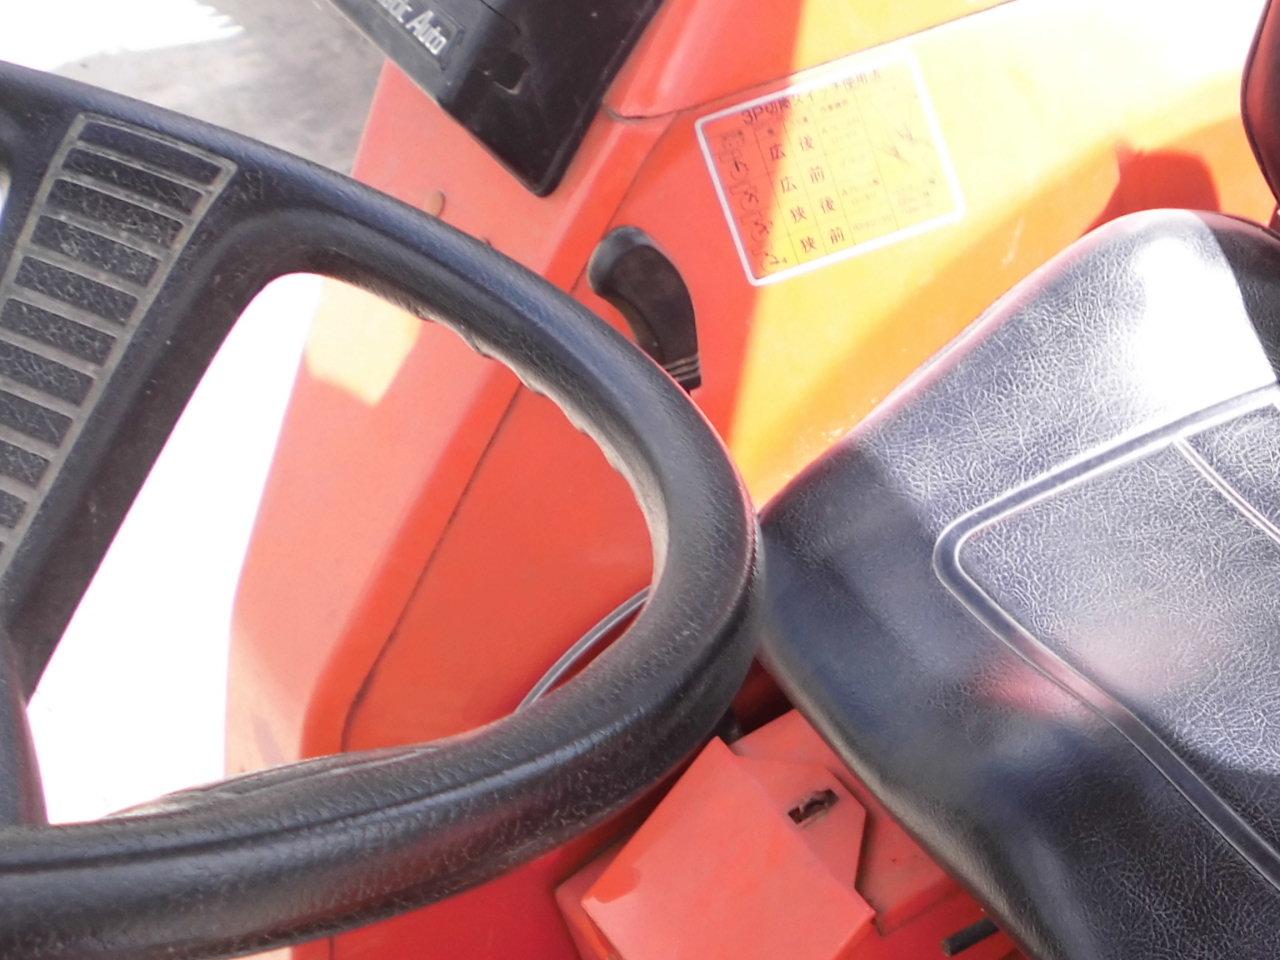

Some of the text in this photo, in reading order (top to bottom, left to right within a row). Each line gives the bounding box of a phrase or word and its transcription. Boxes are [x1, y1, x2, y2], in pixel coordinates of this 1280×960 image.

[405, 10, 447, 56] Auto
[809, 164, 826, 184] 前
[828, 225, 846, 246] 前
